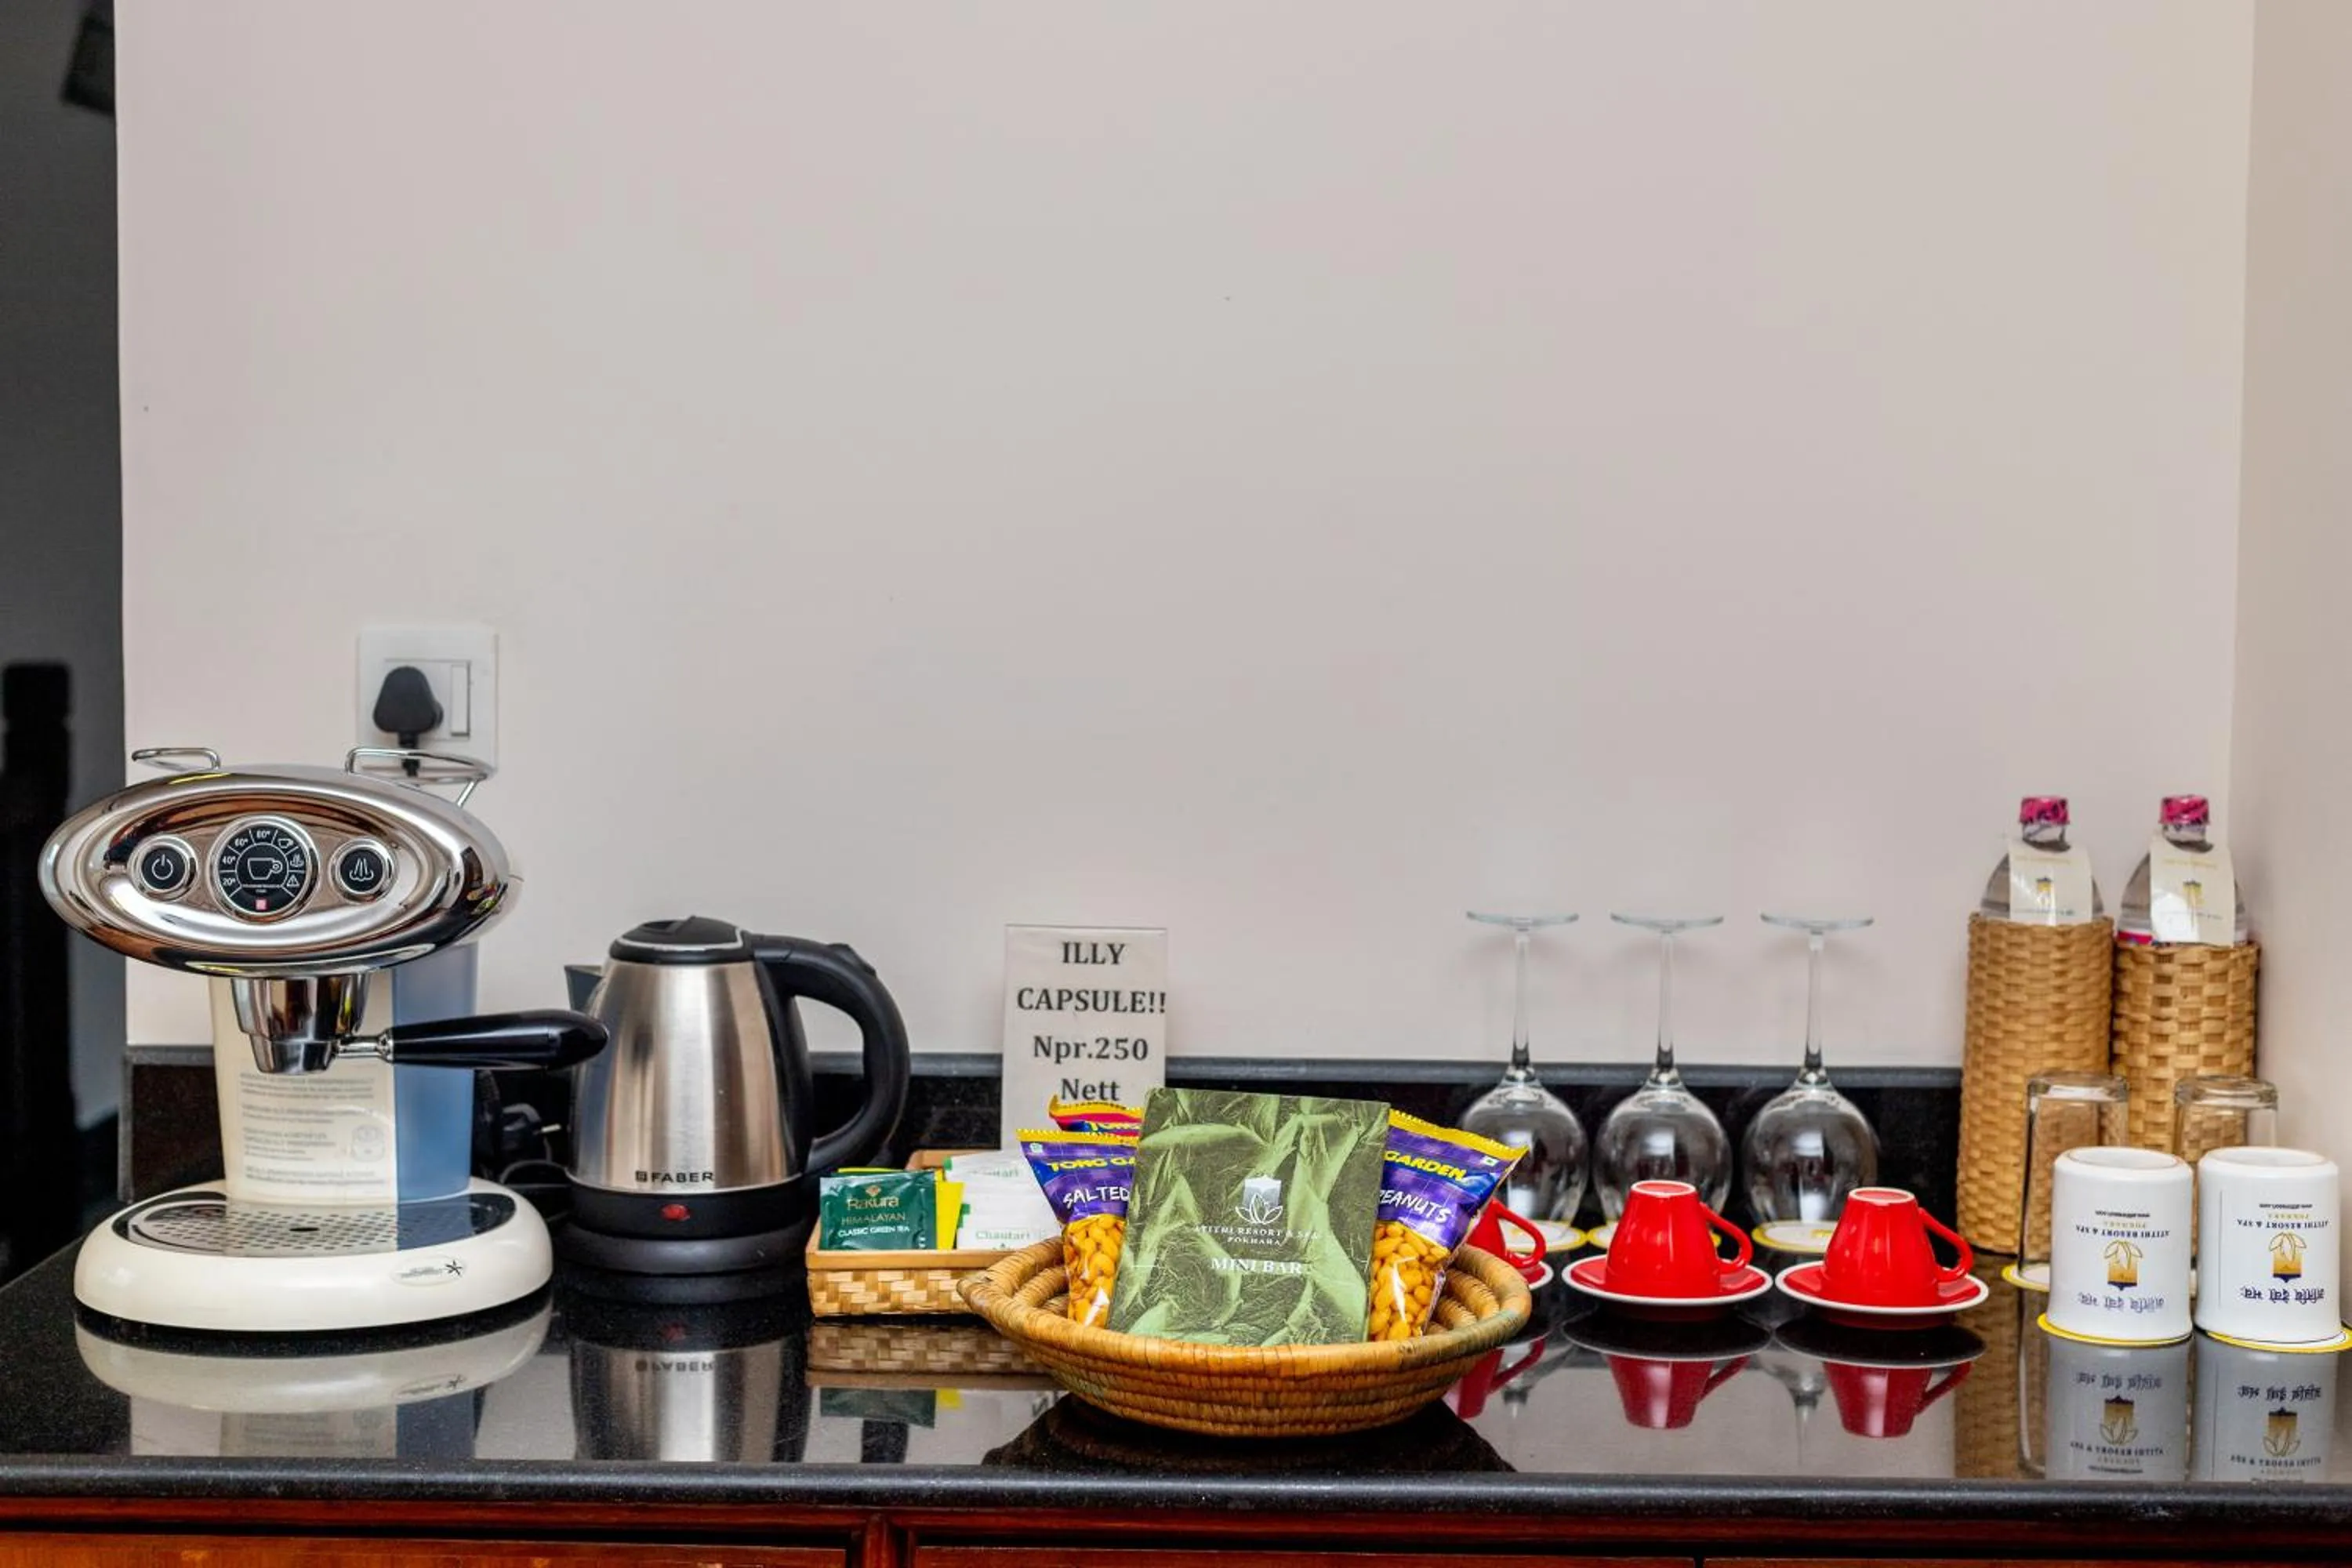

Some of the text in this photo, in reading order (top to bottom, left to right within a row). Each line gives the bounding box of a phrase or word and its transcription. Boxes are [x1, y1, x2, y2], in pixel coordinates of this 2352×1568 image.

[1062, 942, 1125, 965] ILLY
[1017, 987, 1167, 1014] CAPSULE!!
[1033, 1036, 1149, 1064] Npr.250
[1062, 1078, 1120, 1101] Nett
[1047, 1158, 1108, 1172] TONG
[1384, 1150, 1468, 1181] GARDEN
[652, 1172, 713, 1183] FABER
[847, 1196, 899, 1210] Rakura
[1063, 1185, 1130, 1209] SALTED
[841, 1211, 906, 1225] HIMALAYAN
[837, 1228, 869, 1237] CLASSIC
[1237, 1227, 1283, 1236] RESORT
[1210, 1258, 1302, 1274] MINI BAR
